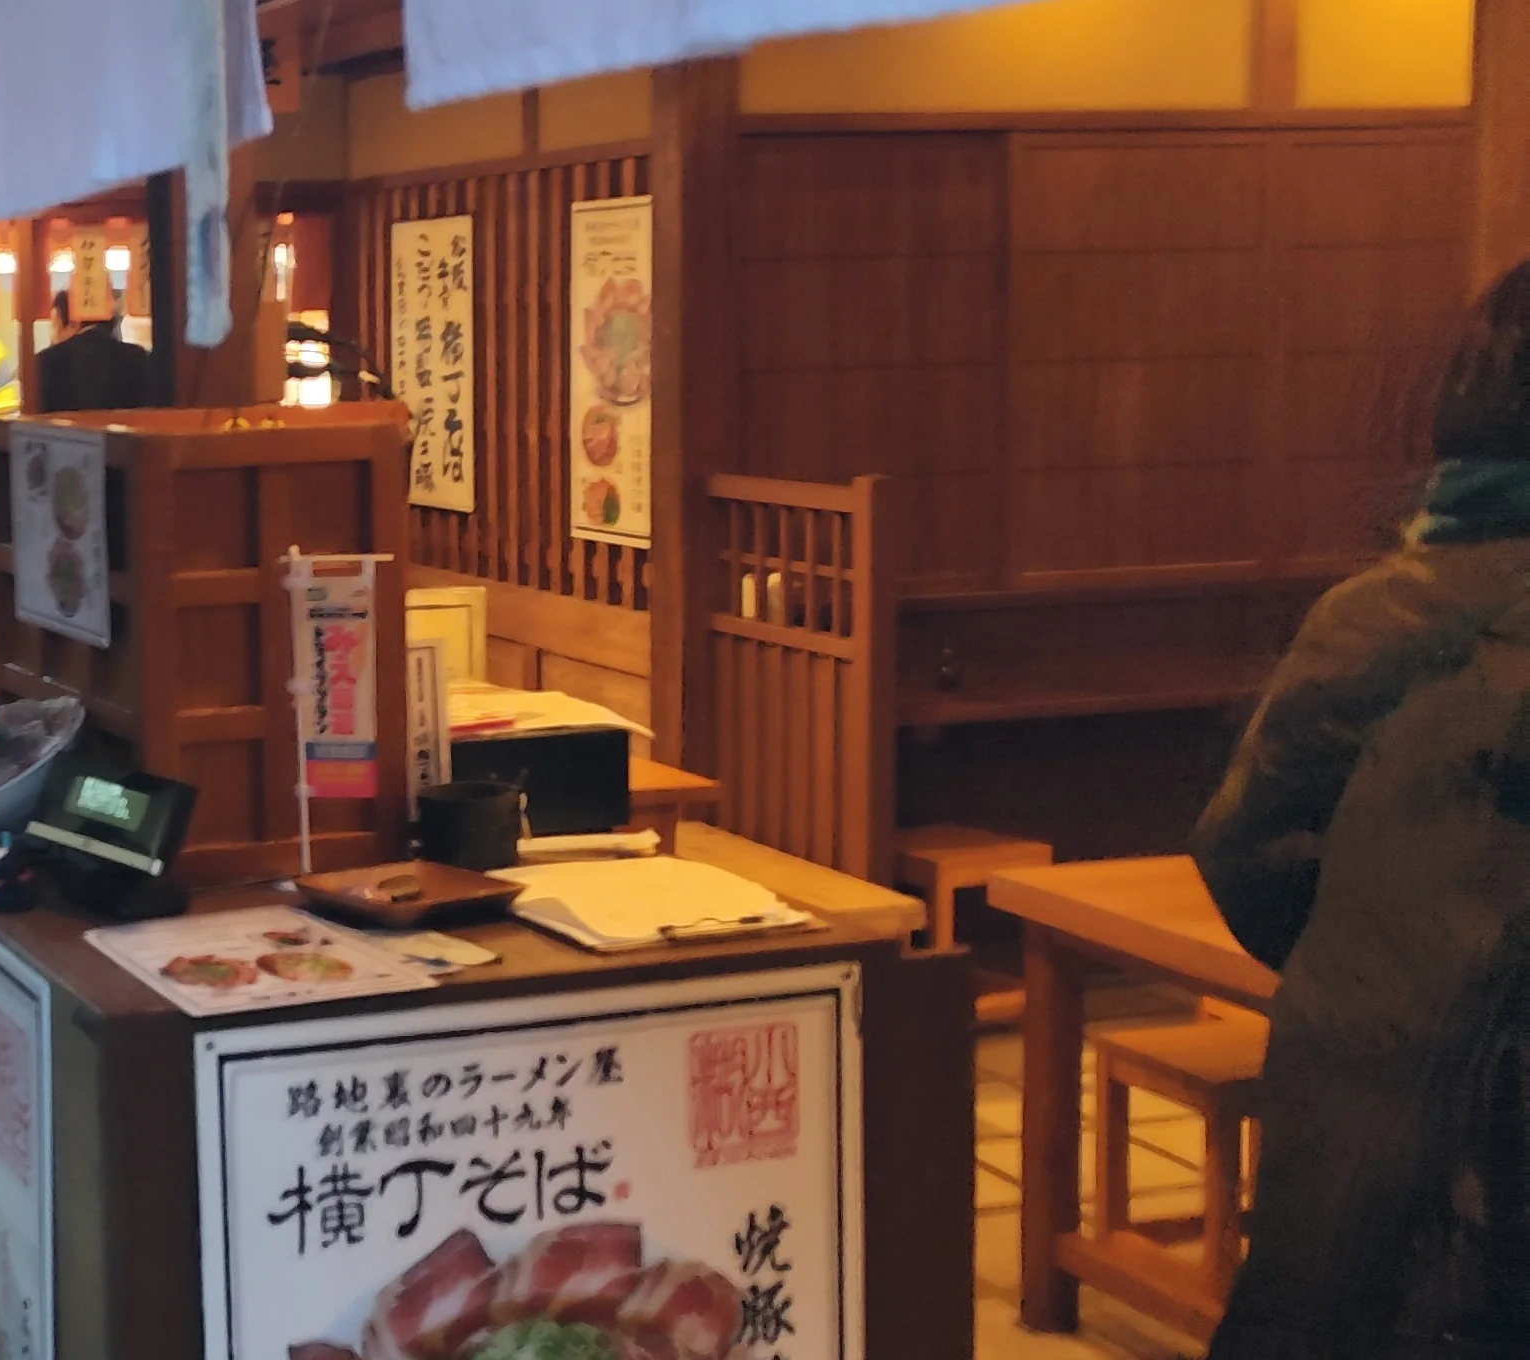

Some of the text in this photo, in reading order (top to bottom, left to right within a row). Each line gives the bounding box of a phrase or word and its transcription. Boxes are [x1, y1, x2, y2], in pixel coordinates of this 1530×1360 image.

[286, 1044, 624, 1120] 路地裏のラーメン屋
[266, 1138, 614, 1256] 横丁そば
